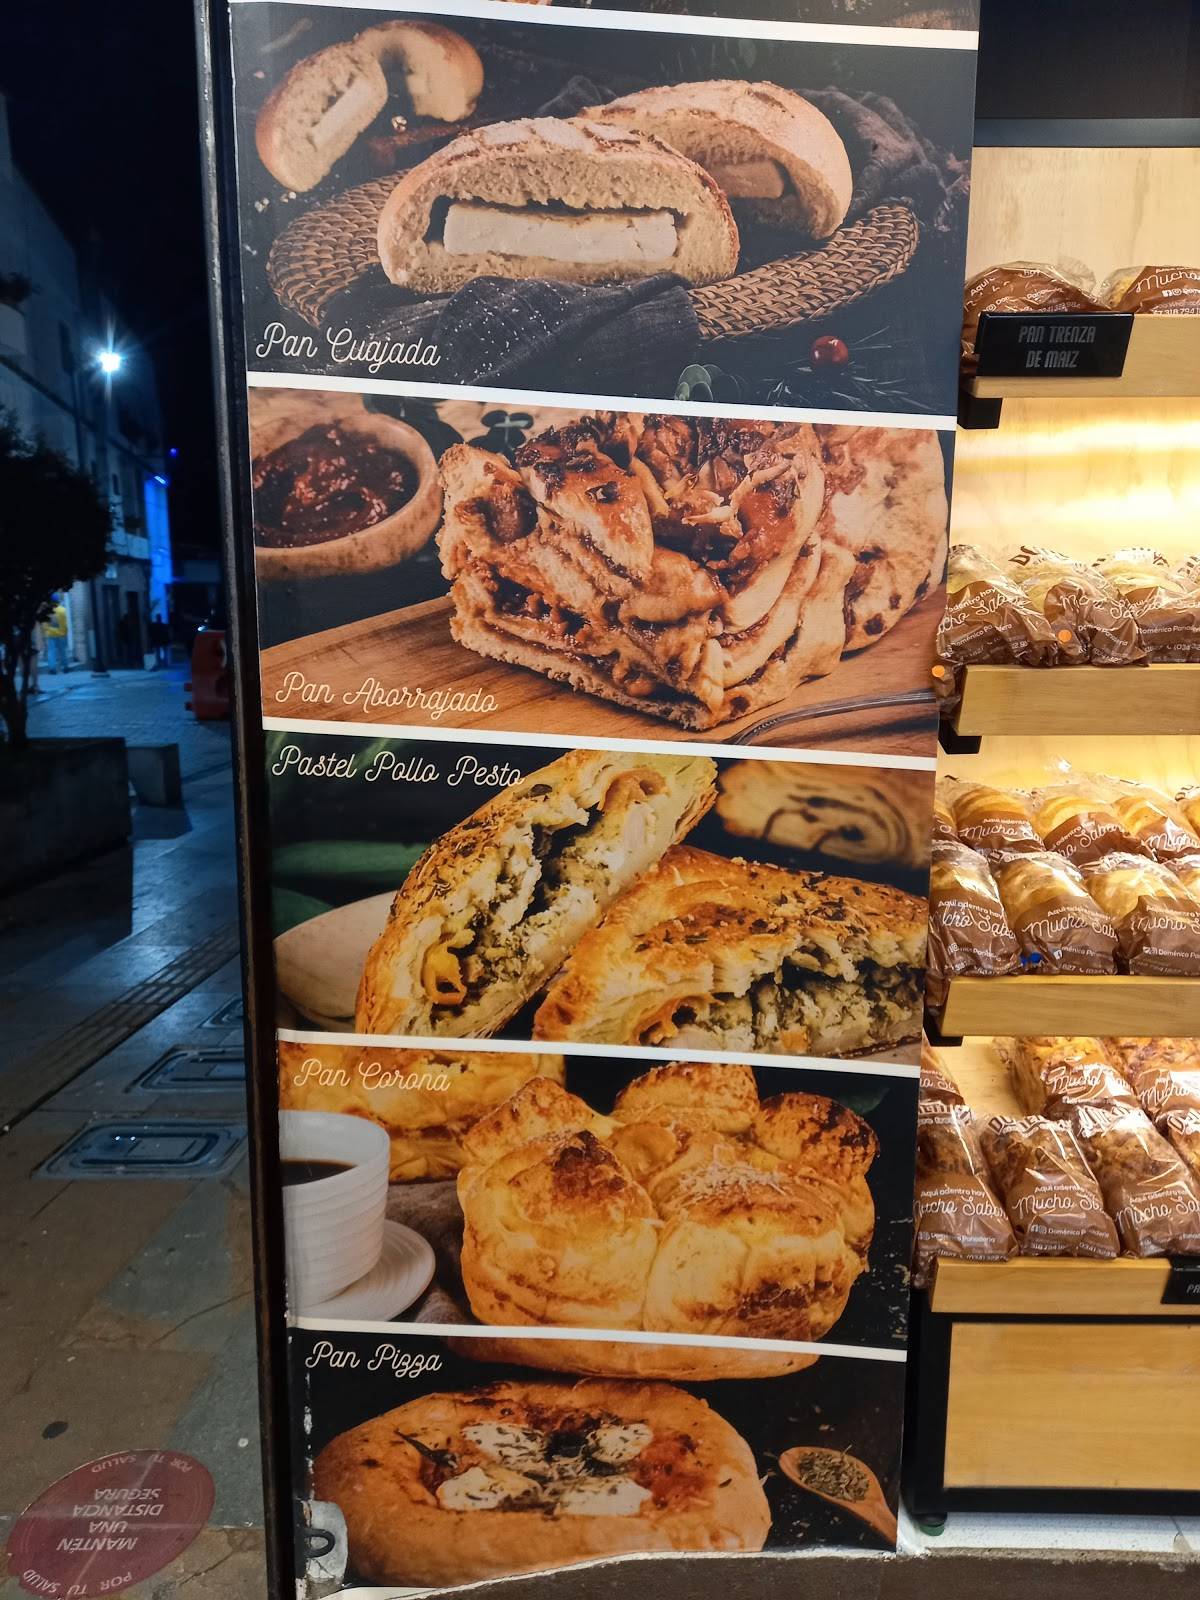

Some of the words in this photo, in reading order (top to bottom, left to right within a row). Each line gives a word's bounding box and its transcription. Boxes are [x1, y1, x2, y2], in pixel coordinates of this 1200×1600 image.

[1018, 325, 1045, 343] PAN
[1049, 326, 1097, 343] TRENZA
[256, 322, 318, 358] Pan
[326, 327, 441, 373] Cuajada
[1026, 350, 1042, 368] DE
[275, 671, 334, 703] Pan
[343, 677, 498, 721] Aborrajado
[272, 745, 358, 777] Pastel
[365, 751, 440, 783] Pollo
[447, 755, 525, 787] Pesto
[1021, 913, 1087, 941] Mucho
[293, 1058, 350, 1087] Pan
[358, 1061, 451, 1092] Corona
[1012, 1193, 1075, 1220] Mucho
[305, 1340, 361, 1368] Pan
[367, 1344, 443, 1378] Pizza
[91, 1454, 137, 1474] SALUD
[93, 1488, 162, 1501] SEGURA
[72, 1504, 165, 1517] DISTANCIA
[88, 1520, 128, 1534] UNA
[56, 1536, 139, 1554] MANTÉN
[22, 1568, 62, 1594] SALUD
[67, 1583, 89, 1596] TU
[99, 1571, 133, 1592] POR
